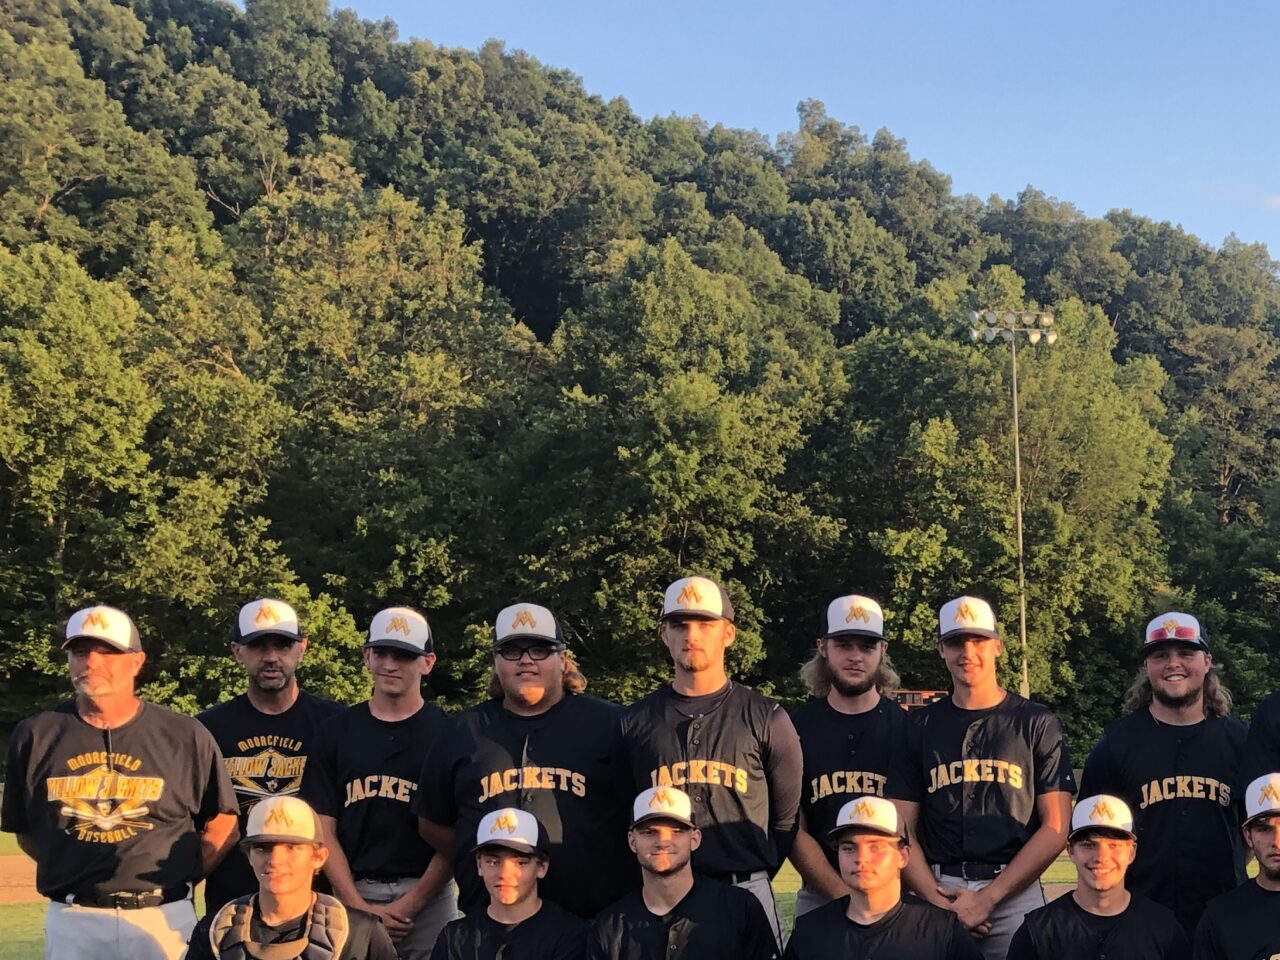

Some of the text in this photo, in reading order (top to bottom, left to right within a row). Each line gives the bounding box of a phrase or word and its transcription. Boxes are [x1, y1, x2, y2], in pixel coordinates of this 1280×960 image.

[677, 586, 703, 606] M
[81, 611, 109, 631] M
[255, 605, 281, 625] M
[512, 611, 536, 629] M
[846, 605, 870, 623] M
[953, 602, 978, 623] M
[386, 617, 411, 636] M
[237, 734, 303, 752] MOOREFIELD
[478, 766, 586, 803] JACKETS
[928, 758, 1023, 793] JACKETS
[98, 776, 164, 800] JCKETS
[344, 774, 418, 808] JACKE
[810, 770, 887, 804] JACKET
[1139, 775, 1231, 809] JACKETS
[649, 788, 676, 808] M
[265, 807, 293, 827] M
[849, 799, 875, 820] M
[1089, 801, 1115, 821] M
[491, 814, 516, 834] M
